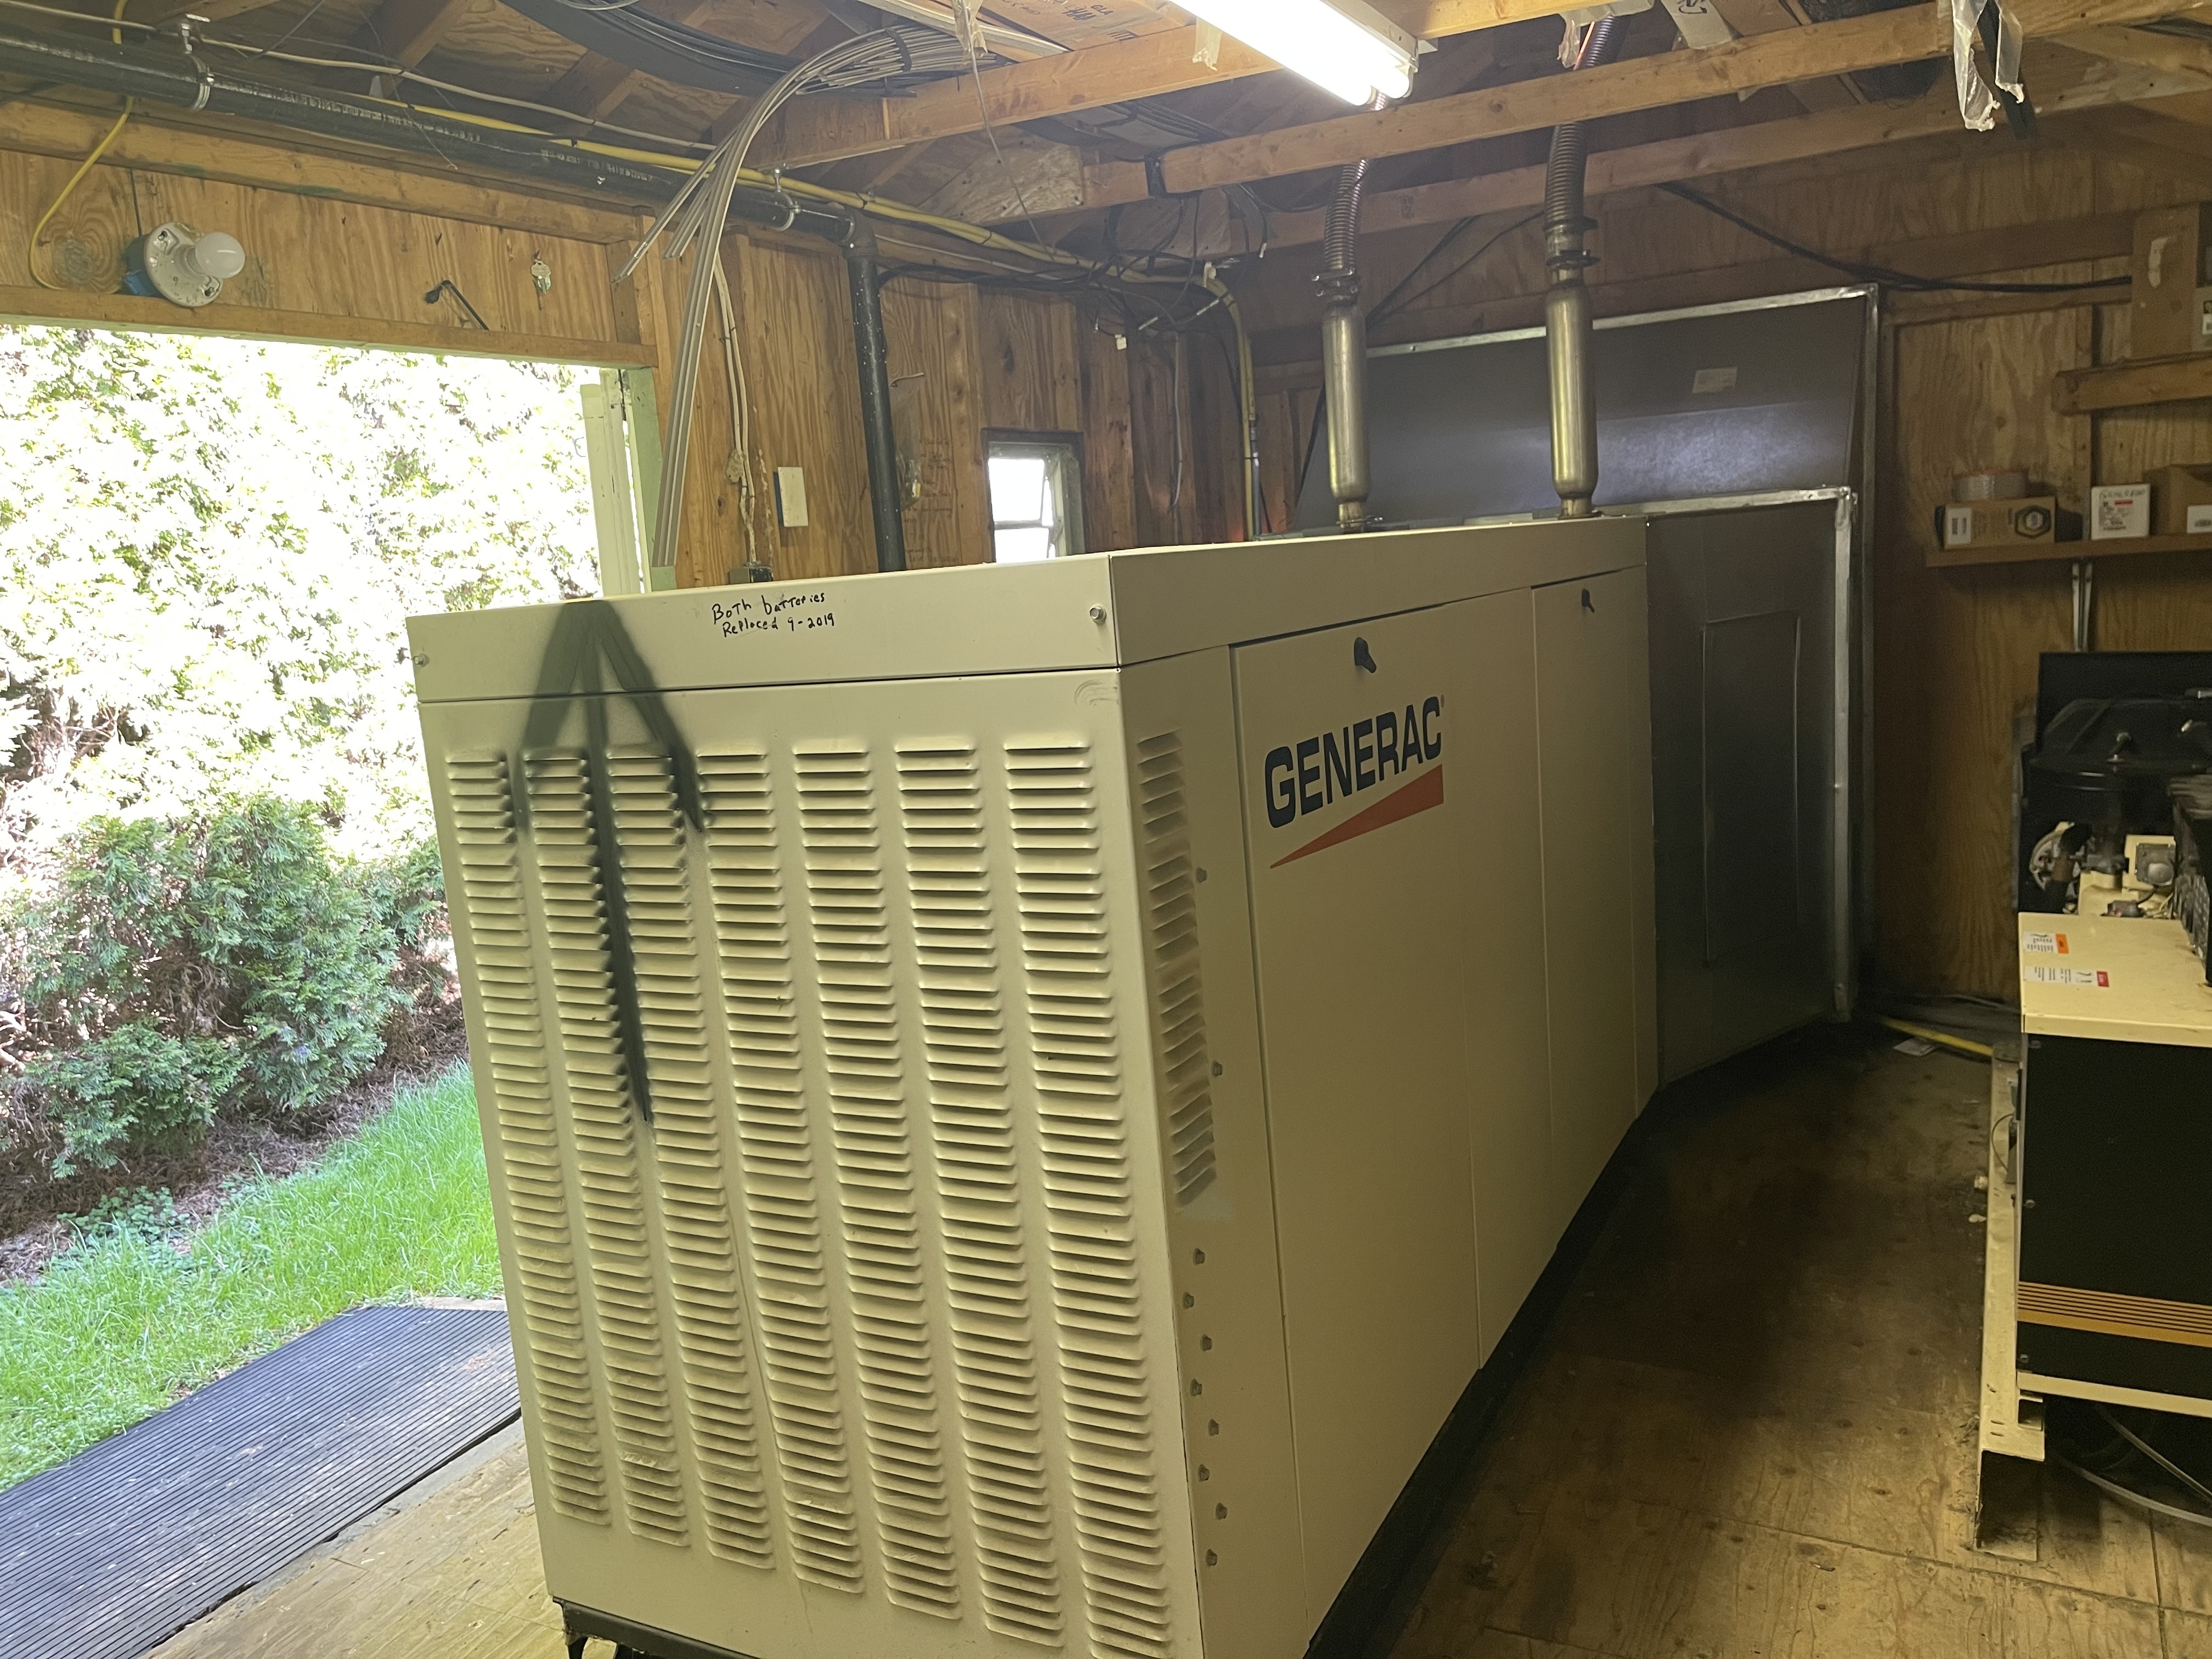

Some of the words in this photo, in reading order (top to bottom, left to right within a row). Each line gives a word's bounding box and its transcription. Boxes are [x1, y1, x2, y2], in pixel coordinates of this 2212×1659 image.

[722, 616, 778, 637] Replaced
[787, 612, 834, 631] 9-2019
[1265, 696, 1442, 829] GENERAC
